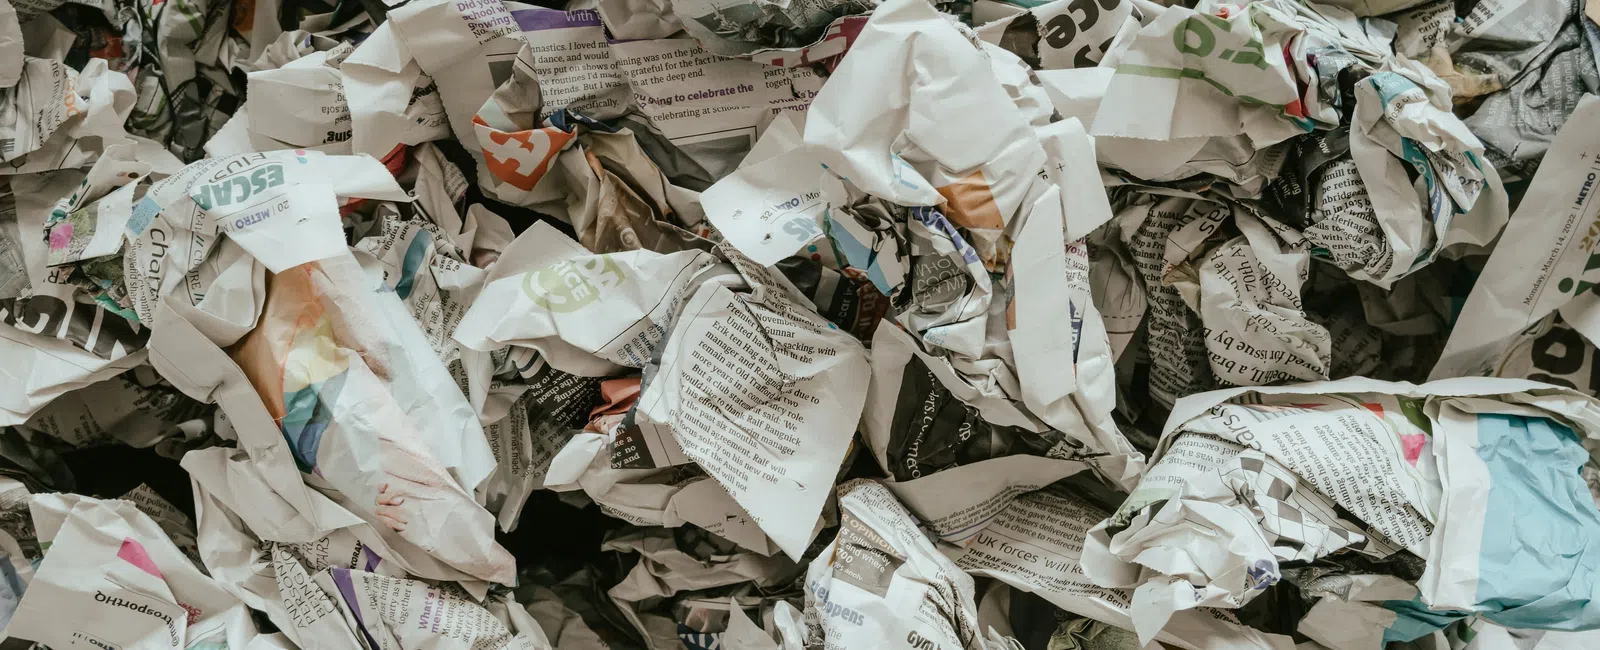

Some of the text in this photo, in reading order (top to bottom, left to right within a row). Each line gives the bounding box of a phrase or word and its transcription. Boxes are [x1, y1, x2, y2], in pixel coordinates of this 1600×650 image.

[564, 10, 593, 22] With
[538, 51, 610, 65] dance, and would
[573, 41, 597, 51] loved
[643, 46, 705, 63] was on the job
[551, 74, 586, 86] routines
[553, 61, 609, 75] put shows
[630, 56, 711, 79] grateful for the fact
[649, 69, 707, 85] the deep end.
[550, 80, 622, 97] friends. But was
[686, 83, 755, 103] celebrate the
[653, 108, 702, 123] celebrating
[235, 199, 290, 230] 20 METRO
[760, 210, 774, 222] 32
[1523, 273, 1546, 306] Monday,
[1540, 247, 1561, 274] March
[1561, 212, 1577, 235] 2022
[1574, 171, 1597, 207] METRO
[726, 301, 756, 329] Premier
[711, 320, 760, 361] Erik ten Hag
[726, 316, 770, 355] United have
[764, 326, 796, 340] Gunnar
[1212, 330, 1234, 351] by
[698, 339, 725, 365] remain
[735, 365, 750, 382] Old
[705, 330, 755, 371] manager and
[783, 341, 838, 358] sacking, with
[691, 349, 735, 386] more years
[685, 387, 698, 400] his
[692, 362, 782, 425] But club said:
[686, 399, 699, 414] the
[698, 409, 717, 424] past
[716, 418, 728, 432] six
[728, 426, 760, 451] months.
[725, 401, 746, 420] thank
[746, 411, 766, 429] Ralf
[764, 420, 803, 448] Rangnick
[788, 410, 806, 425] role.
[684, 411, 711, 433] mutual
[710, 428, 751, 461] agreement,
[752, 452, 770, 468] Ralf
[769, 462, 787, 477] will
[761, 431, 796, 457] manager
[1271, 433, 1291, 457] Steele
[1281, 430, 1309, 464] last year
[1292, 428, 1326, 476] handed him
[1313, 424, 1343, 462] campaign
[698, 431, 780, 486] solely his new role
[710, 451, 750, 483] the Austria
[1322, 454, 1340, 478] order.
[706, 459, 721, 475] and
[721, 469, 736, 486] will
[1346, 475, 1360, 495] said
[1028, 508, 1045, 522] gave
[1045, 514, 1059, 524] her
[1058, 519, 1086, 533] details
[1353, 494, 1372, 523] Steele
[1010, 524, 1075, 553] chance redirect
[1015, 514, 1075, 539] letters delivered
[845, 543, 886, 574] and where
[976, 533, 995, 550] UK
[997, 540, 1040, 564] forces
[963, 553, 1001, 572] Cup 2022
[968, 547, 986, 559] THE
[985, 553, 1002, 565] RAF
[1001, 559, 1018, 570] and
[1018, 563, 1039, 579] Navy
[293, 572, 326, 619] BEING
[283, 598, 308, 630] AND
[417, 591, 436, 630] What's
